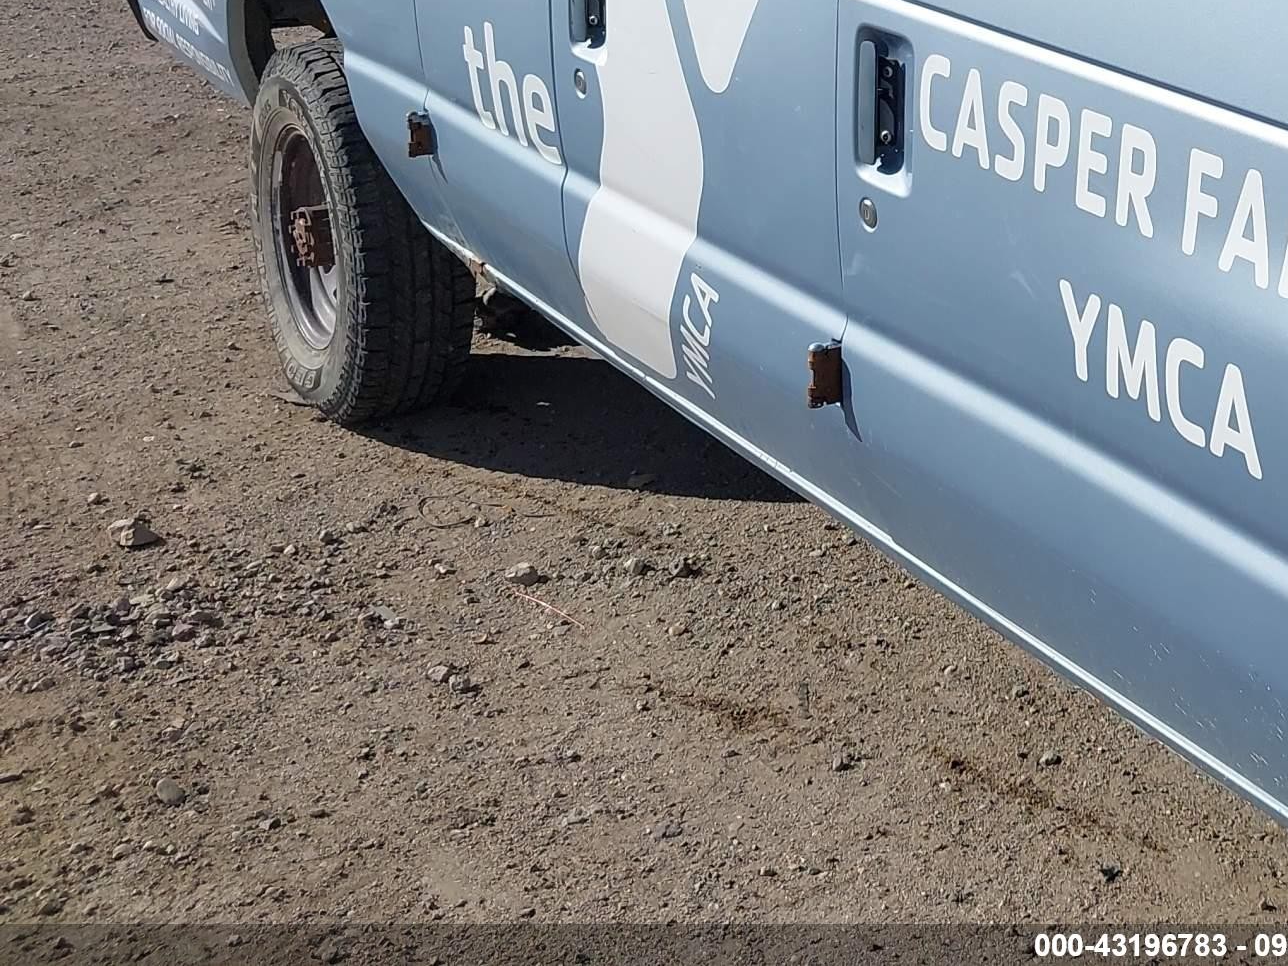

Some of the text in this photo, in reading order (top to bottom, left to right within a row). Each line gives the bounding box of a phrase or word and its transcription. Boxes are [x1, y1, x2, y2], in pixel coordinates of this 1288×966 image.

[463, 20, 562, 165] the
[919, 54, 1158, 238] CASPER
[680, 272, 720, 401] YMCA
[1058, 278, 1263, 480] YMCA
